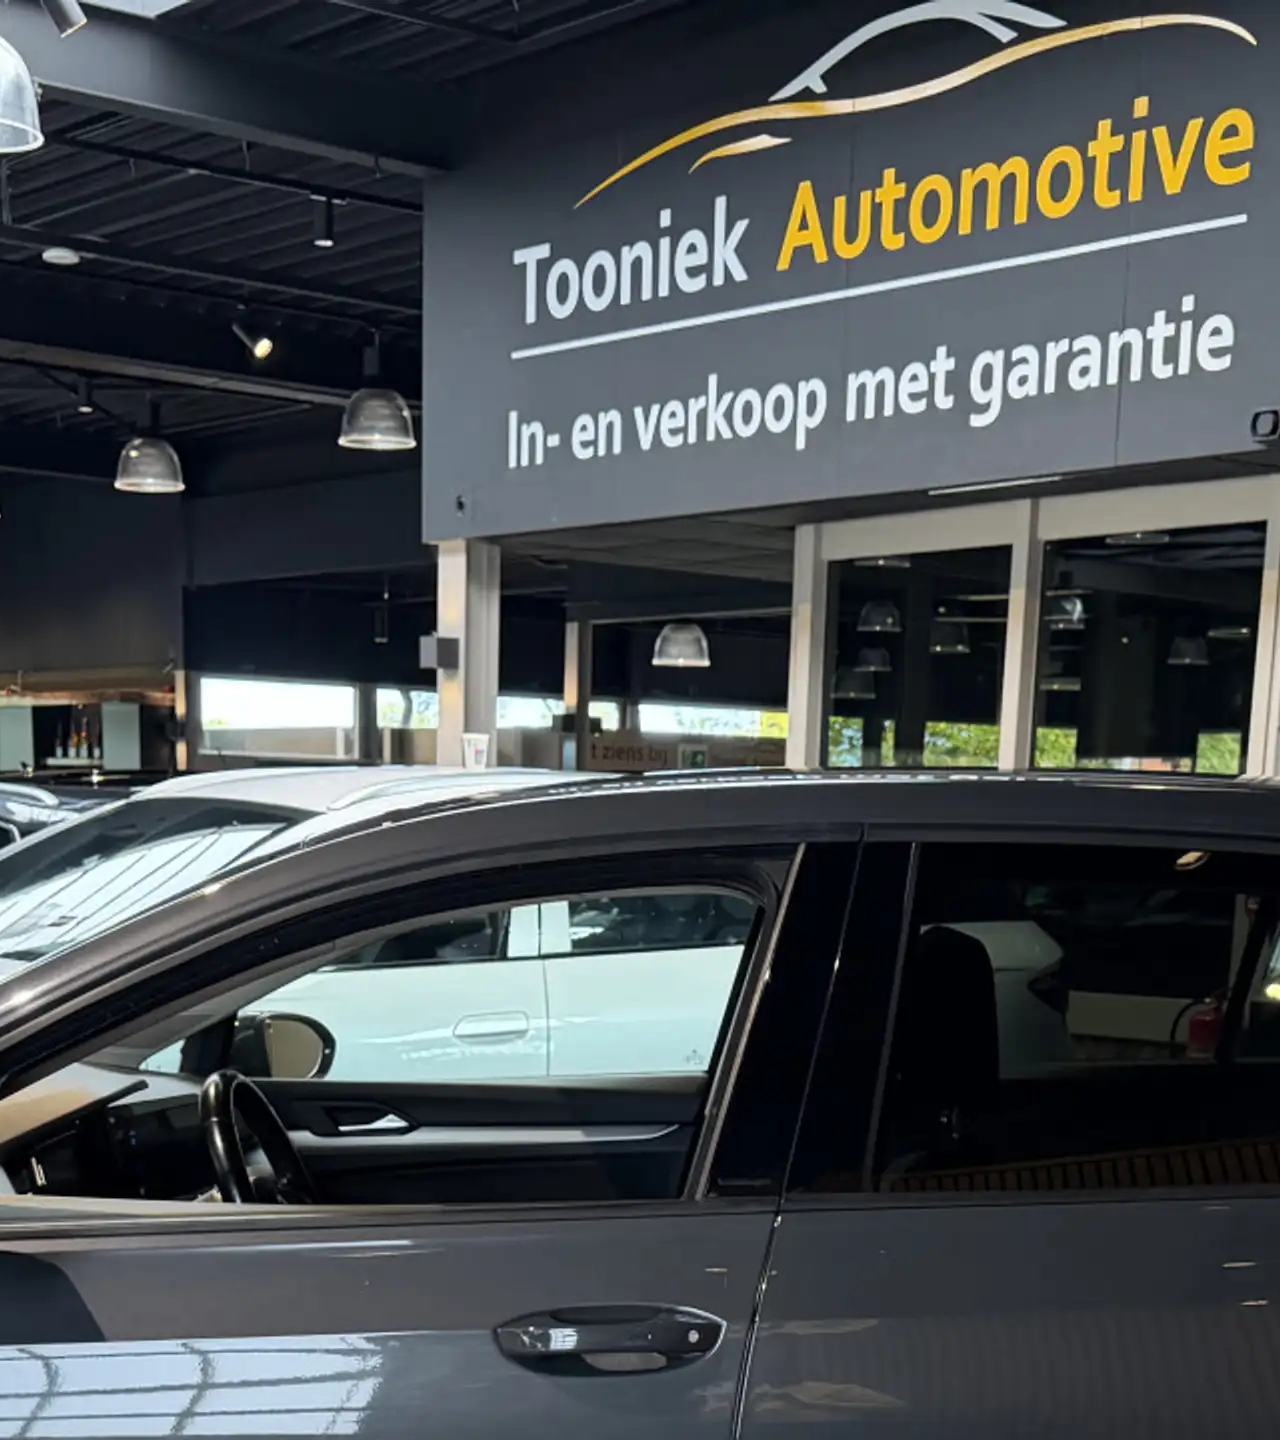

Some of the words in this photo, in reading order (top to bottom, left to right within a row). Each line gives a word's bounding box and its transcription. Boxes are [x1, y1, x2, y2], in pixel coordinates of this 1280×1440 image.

[512, 195, 750, 326] Tooniek
[776, 96, 1256, 272] Automotive
[508, 409, 561, 470] In-
[571, 409, 622, 460] en
[633, 373, 828, 452] verkoop
[845, 345, 956, 423] met
[969, 293, 1236, 429] garantie
